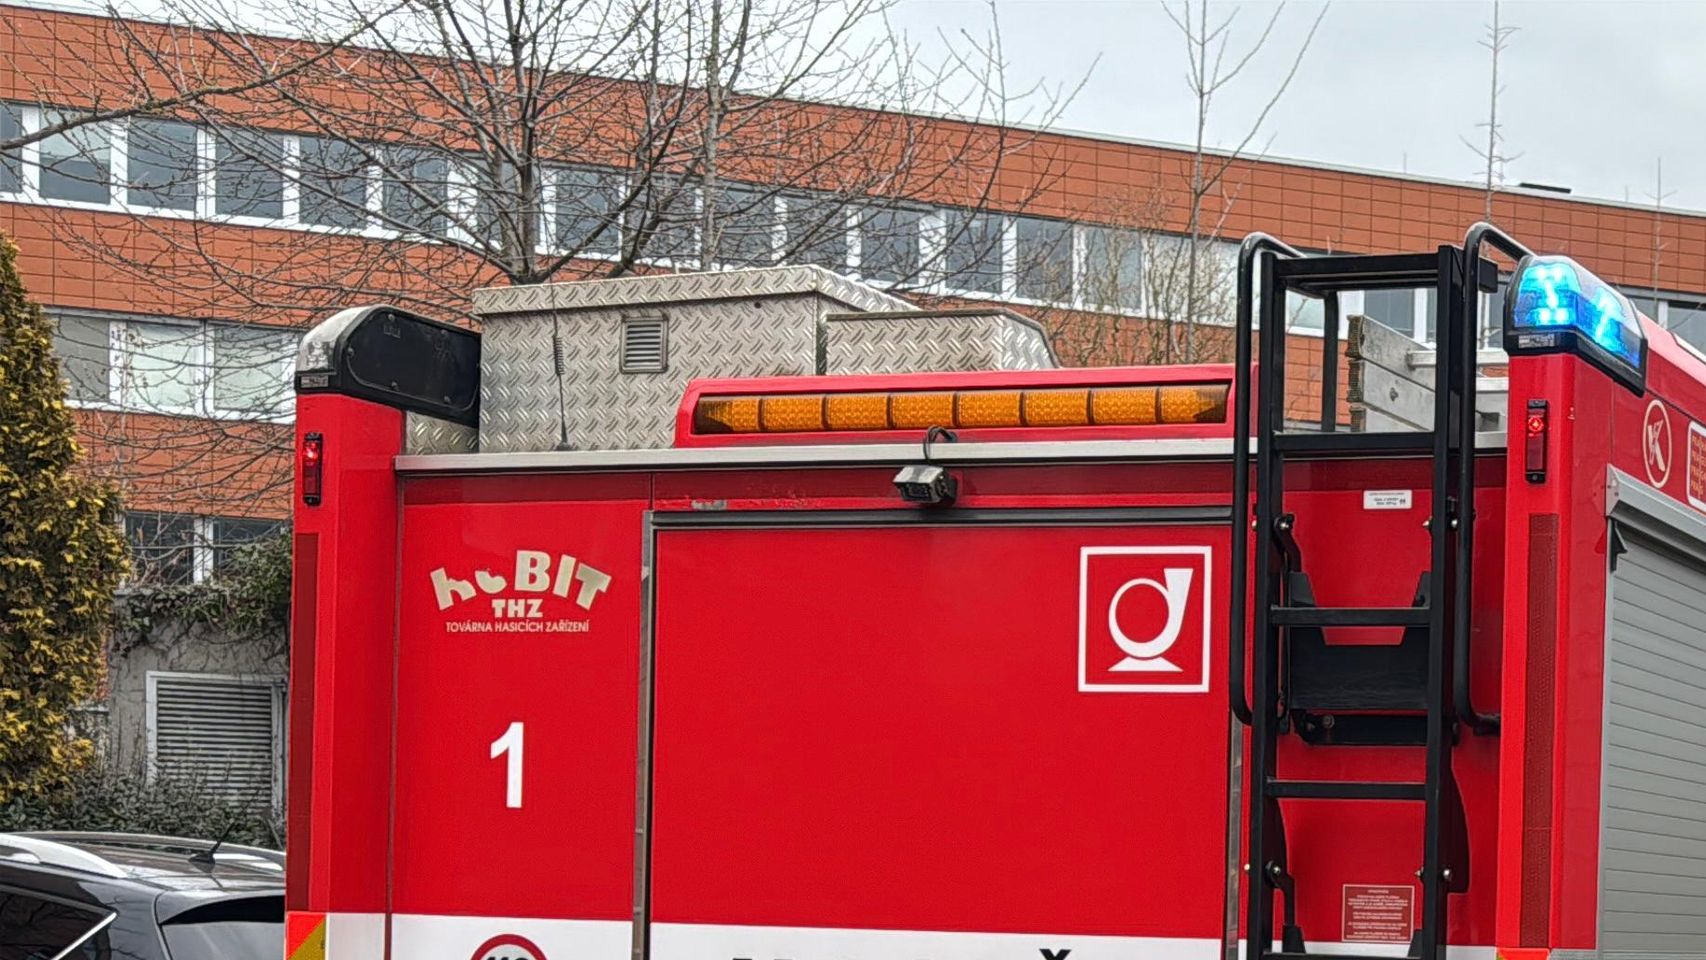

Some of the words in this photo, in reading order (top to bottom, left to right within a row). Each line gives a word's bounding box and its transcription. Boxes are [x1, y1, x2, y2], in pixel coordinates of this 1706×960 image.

[491, 599, 544, 618] THZ
[446, 619, 493, 633] TOVÁRNA
[495, 619, 544, 633] HASICÍCH
[546, 619, 590, 633] ZAŘÍZENÍ
[490, 721, 524, 808] 1
